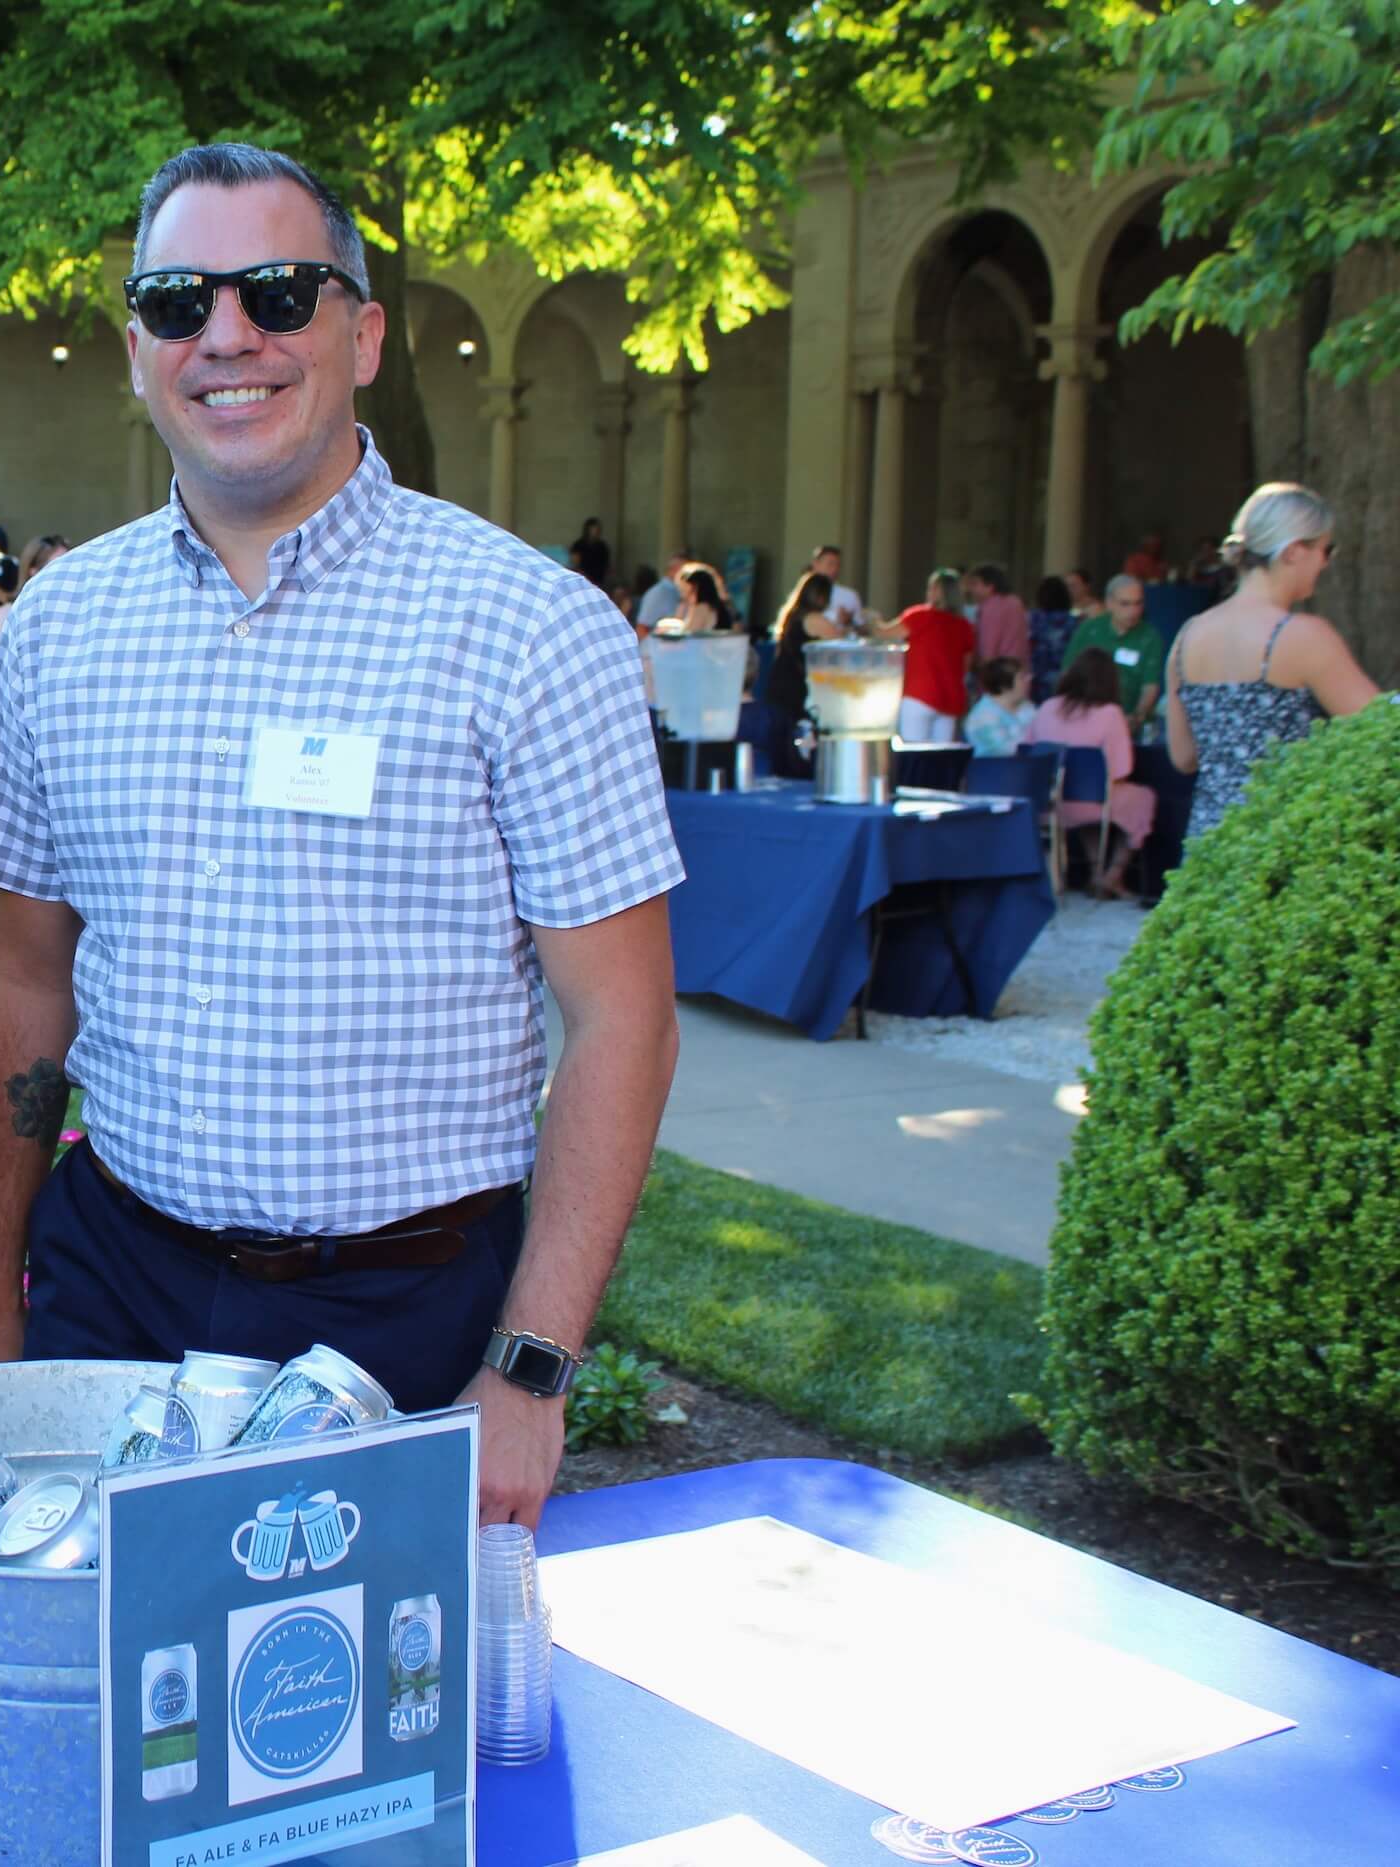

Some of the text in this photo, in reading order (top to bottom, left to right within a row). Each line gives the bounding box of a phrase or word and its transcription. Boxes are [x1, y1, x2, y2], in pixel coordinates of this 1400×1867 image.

[300, 764, 321, 776] Alex
[262, 1624, 331, 1656] BORN IN THE
[264, 1653, 344, 1699] Faith
[243, 1688, 348, 1739] American
[390, 1701, 439, 1734] FAITH
[175, 1797, 414, 1867] FA ALE & FA BLUE HAZY IPA
